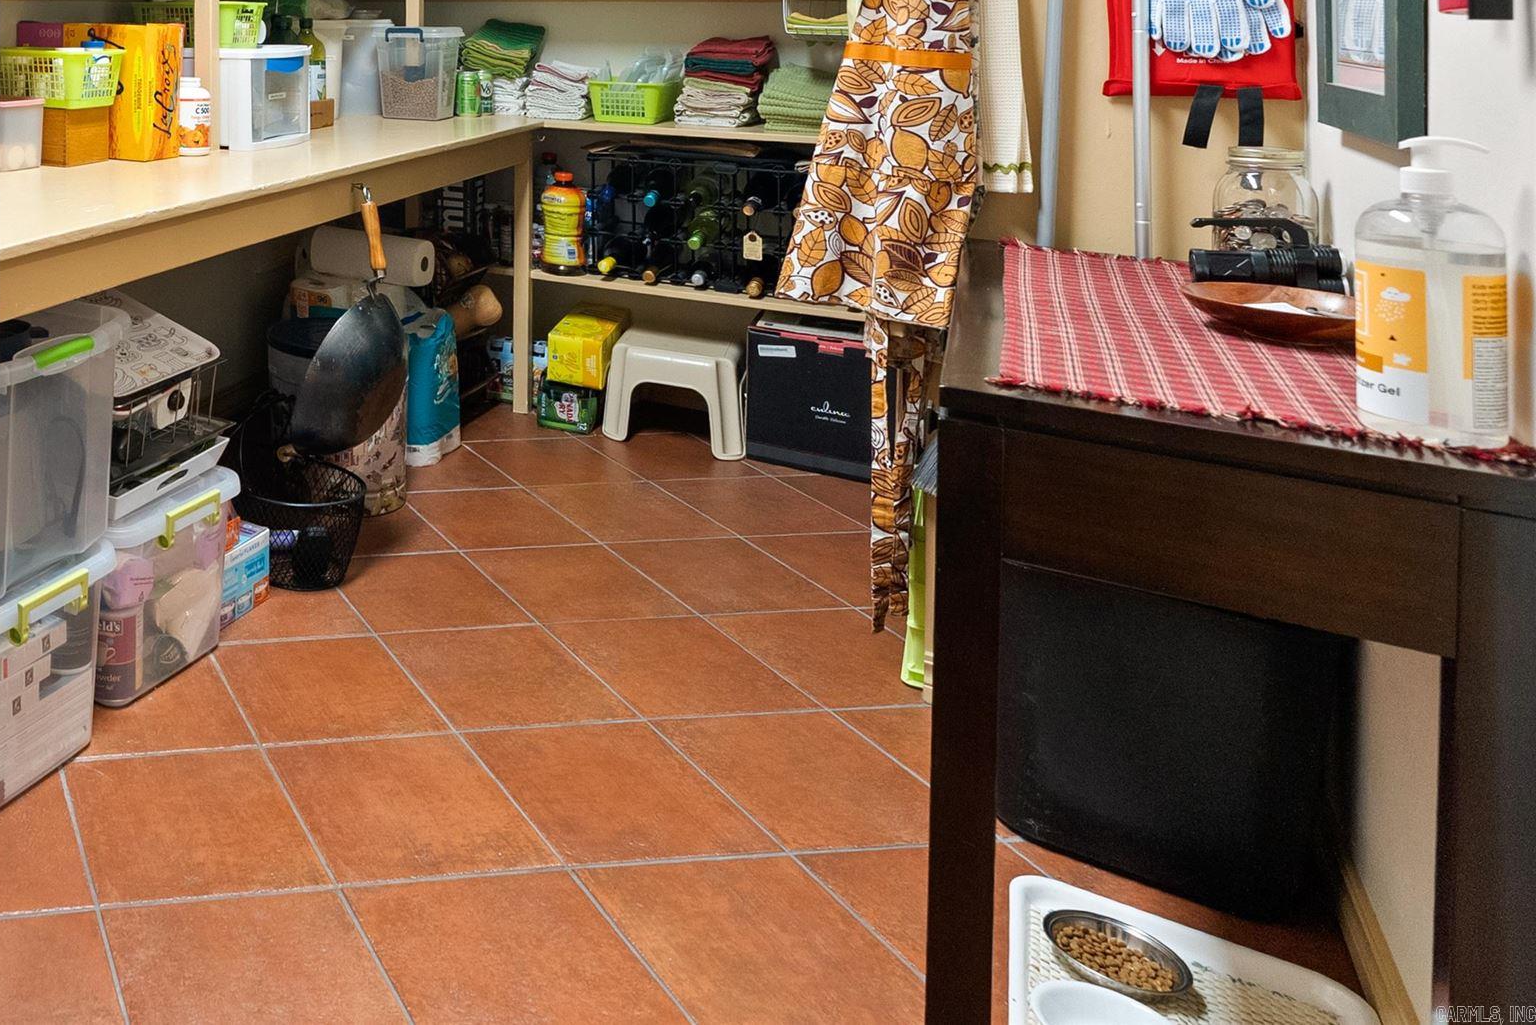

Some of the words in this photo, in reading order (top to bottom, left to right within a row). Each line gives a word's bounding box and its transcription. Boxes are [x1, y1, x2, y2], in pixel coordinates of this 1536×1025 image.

[152, 47, 177, 139] LaCroix
[480, 82, 491, 94] V8
[1378, 383, 1401, 397] Gel
